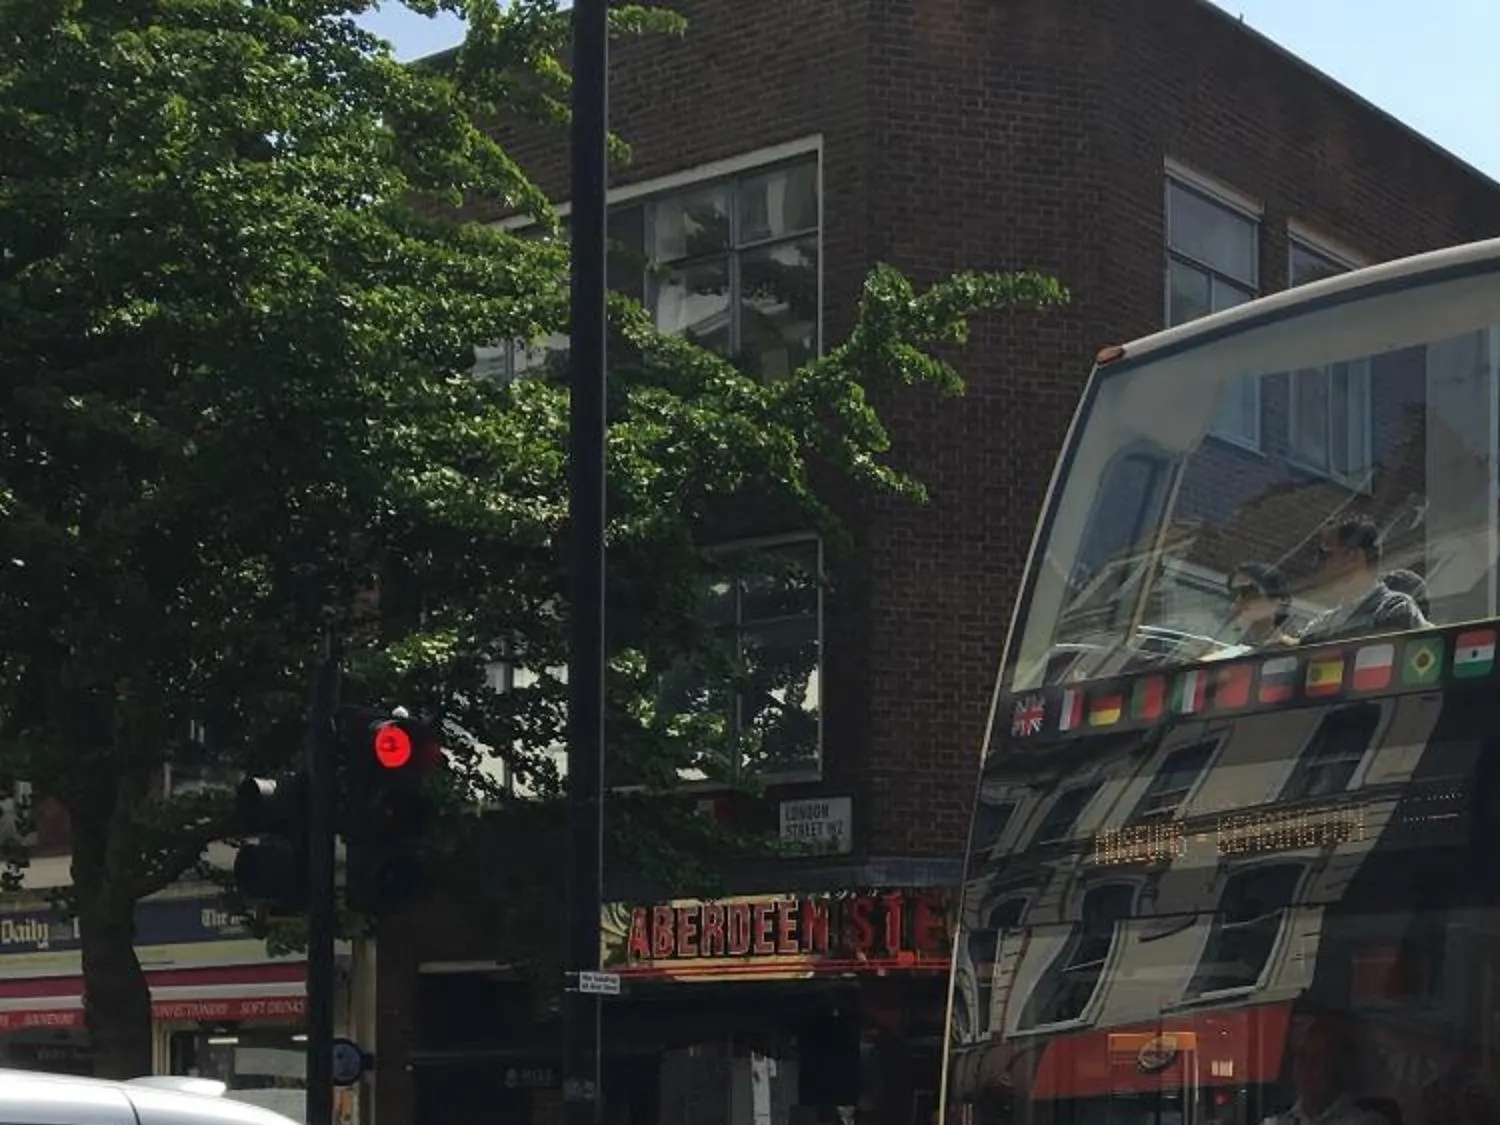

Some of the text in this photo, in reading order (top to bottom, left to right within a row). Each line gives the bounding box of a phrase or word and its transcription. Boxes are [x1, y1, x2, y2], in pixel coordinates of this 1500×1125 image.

[785, 803, 829, 821] LONDON
[0, 917, 49, 949] Daily
[628, 897, 829, 958] ABERDEEN
